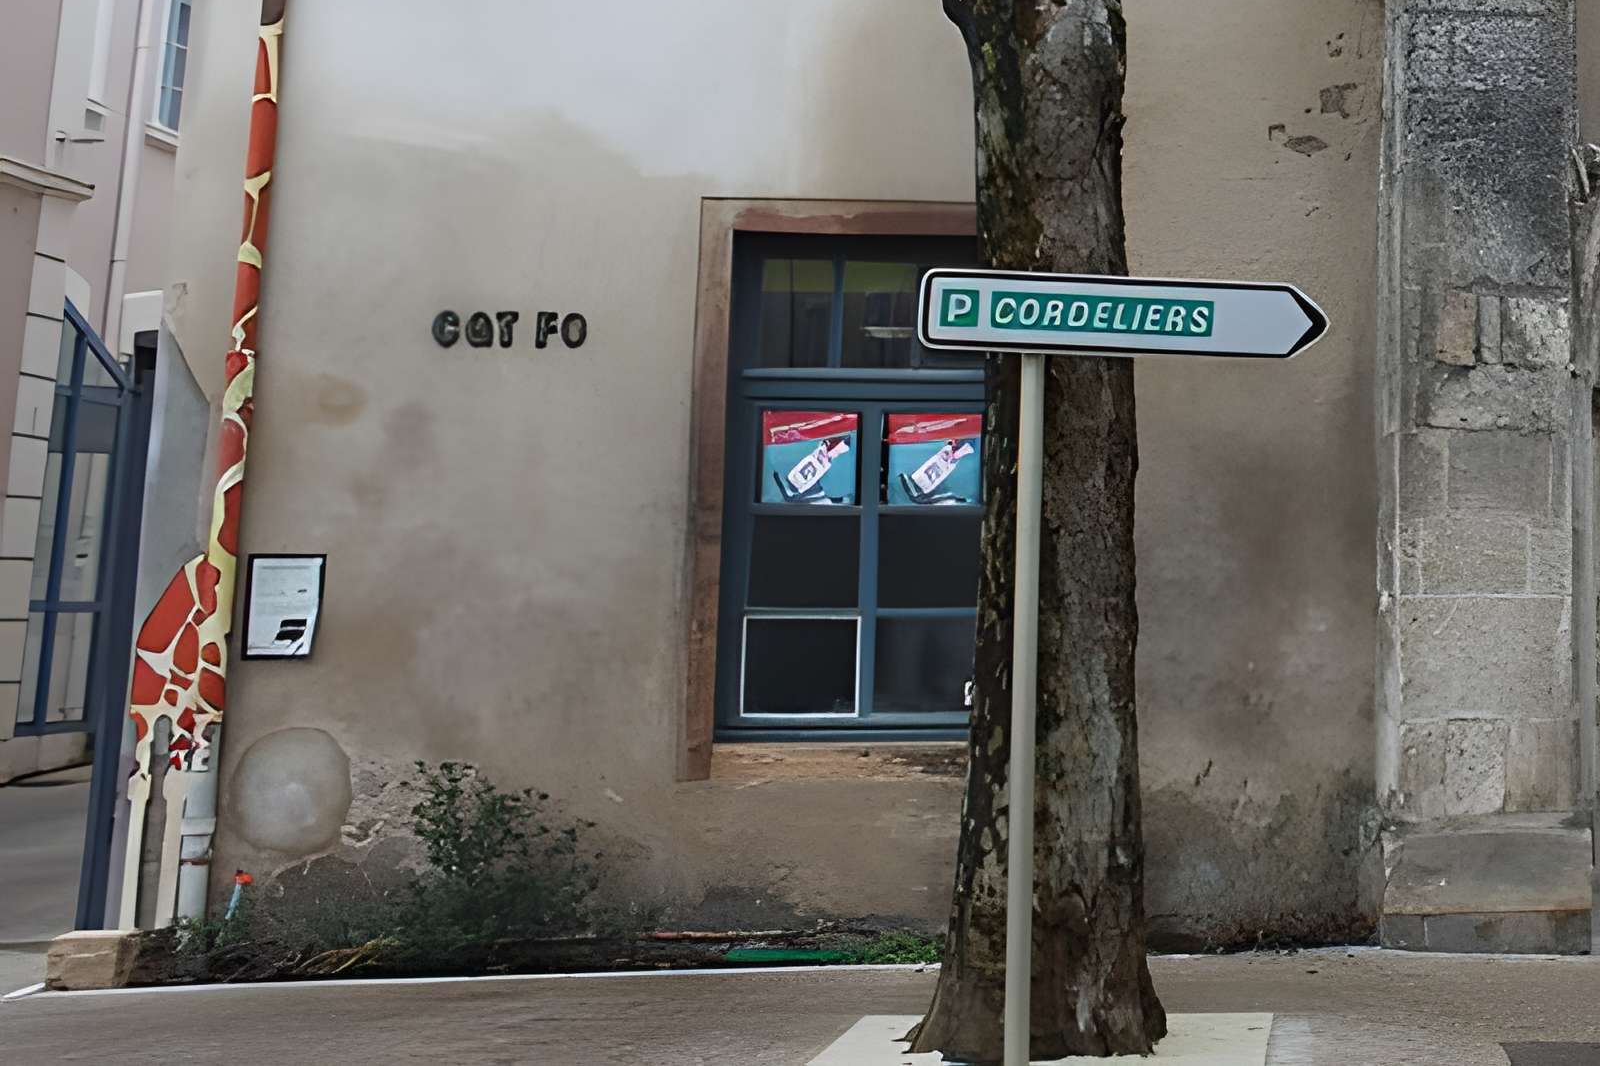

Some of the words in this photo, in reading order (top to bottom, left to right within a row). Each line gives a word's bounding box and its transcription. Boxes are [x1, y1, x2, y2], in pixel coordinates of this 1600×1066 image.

[535, 311, 587, 349] FO
[946, 293, 972, 322] P
[994, 297, 1210, 334] CORDELIERS
